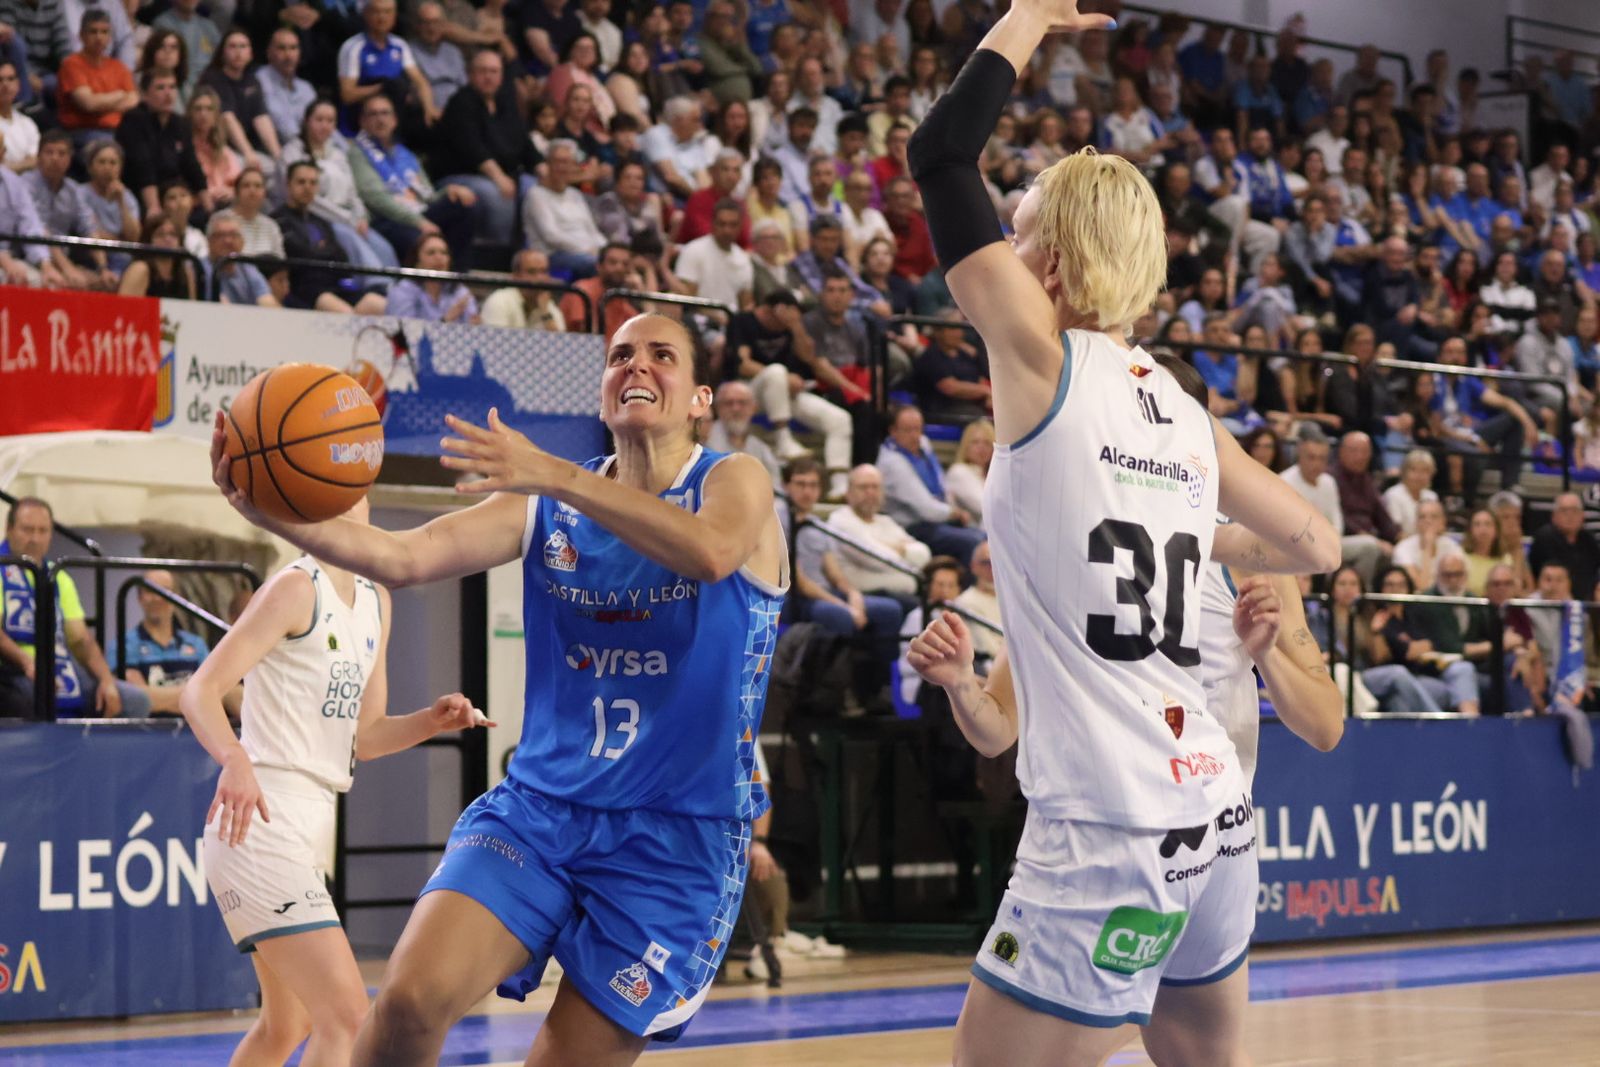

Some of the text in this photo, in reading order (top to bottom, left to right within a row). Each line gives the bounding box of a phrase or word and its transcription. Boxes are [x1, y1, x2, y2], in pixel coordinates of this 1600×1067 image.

[1, 307, 159, 376] La Ranita
[187, 394, 211, 423] de
[1099, 445, 1189, 483] Alcantarilla
[628, 588, 641, 608] Y
[650, 578, 698, 603] LEÓN
[1086, 518, 1202, 668] 30
[590, 696, 640, 760] 13
[1353, 803, 1379, 870] Y
[1391, 782, 1487, 854] LEÓN
[39, 811, 208, 911] LEÓN
[1287, 875, 1400, 928] IMPULSA
[611, 979, 643, 1004] AVENIDA
